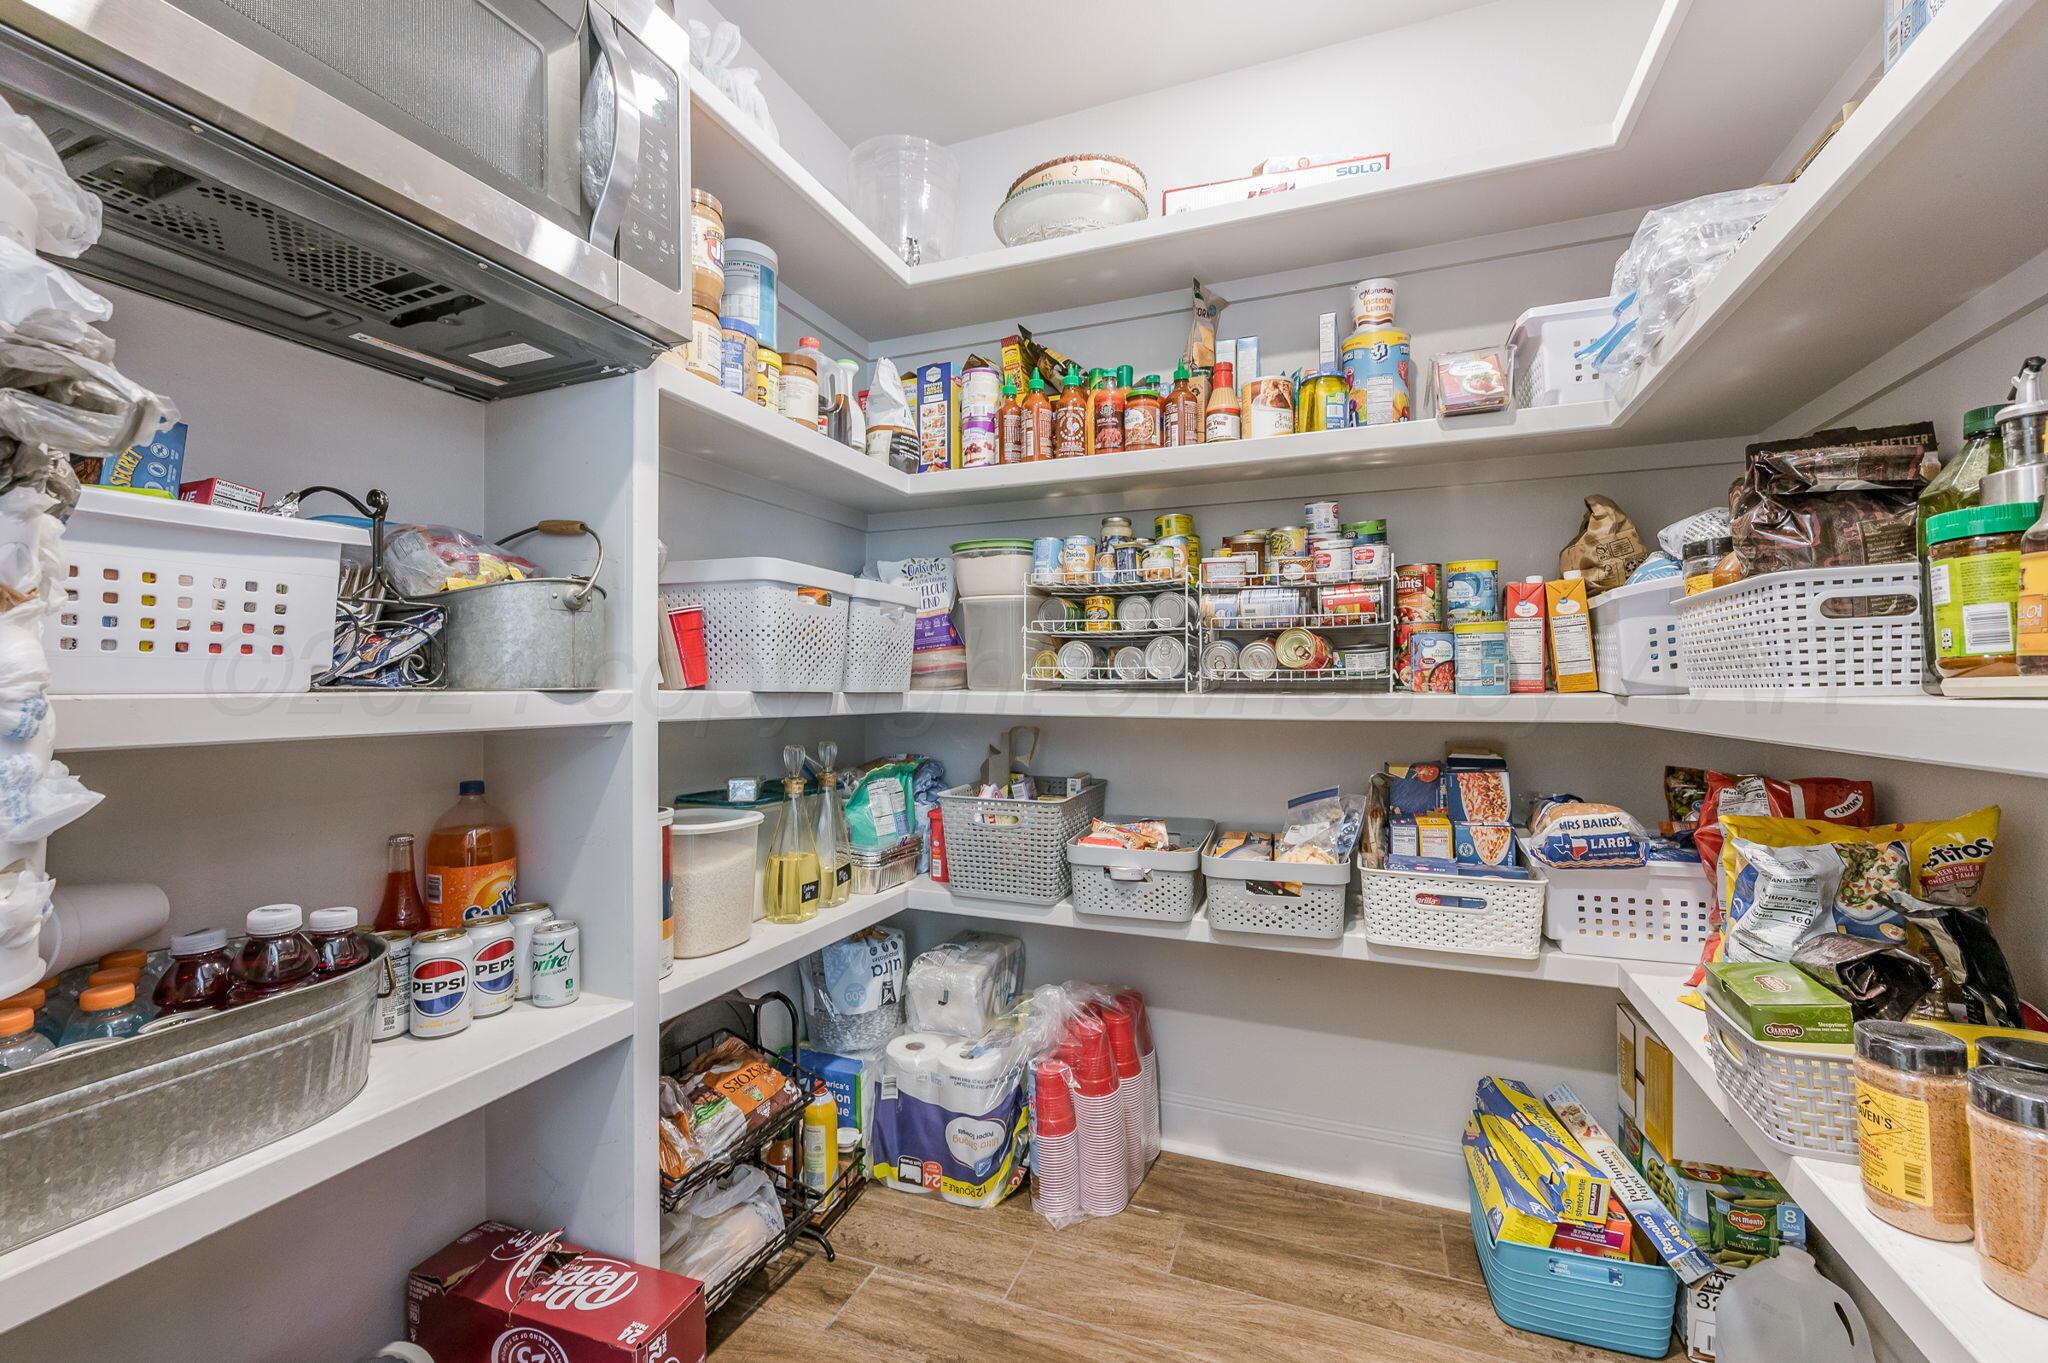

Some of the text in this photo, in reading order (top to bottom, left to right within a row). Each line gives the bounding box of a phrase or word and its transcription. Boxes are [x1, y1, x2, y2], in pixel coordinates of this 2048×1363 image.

[1336, 162, 1382, 177] SOLO
[1359, 286, 1394, 299] Maruchan
[1363, 297, 1392, 306] Instant
[1365, 304, 1391, 313] Lunch
[1882, 433, 1929, 447] BETTER
[111, 447, 143, 487] SECRET
[216, 480, 261, 498] Nutrition Facts
[213, 498, 239, 510] Calories
[921, 582, 948, 597] FLOUR
[1831, 795, 1862, 817] YUMMY
[1559, 816, 1622, 831] MRS BAIRD'S
[1590, 836, 1633, 849] LARGE
[1417, 896, 1437, 905] arilla
[1791, 896, 1817, 906] Facts
[1753, 910, 1812, 925] ories 160
[475, 956, 515, 976] PEPS
[533, 950, 568, 977] prite
[412, 975, 465, 994] PEPSI
[1765, 1025, 1800, 1035] CELESTIAL
[826, 1080, 850, 1090] erica's
[1858, 1105, 1893, 1130] AVEN'S
[952, 1135, 999, 1150] Ultra Strong
[975, 1131, 994, 1140] Paper
[924, 1173, 941, 1188] 24
[1598, 1149, 1643, 1204] Parchment
[949, 1184, 976, 1198] DOUBLE
[1627, 1175, 1653, 1201] Paper
[1576, 1178, 1587, 1217] stretch-tite
[1588, 1184, 1598, 1216] KIRKLAND
[1731, 1214, 1765, 1226] Del Monte
[1784, 1209, 1797, 1225] 8
[1573, 1228, 1606, 1240] STORAGE
[1640, 1213, 1678, 1256] Reynolds
[1782, 1223, 1800, 1231] CANS
[1674, 1234, 1692, 1249] NOW
[631, 1321, 649, 1331] PACK
[529, 1333, 549, 1347] BLEND
[617, 1327, 646, 1345] 24
